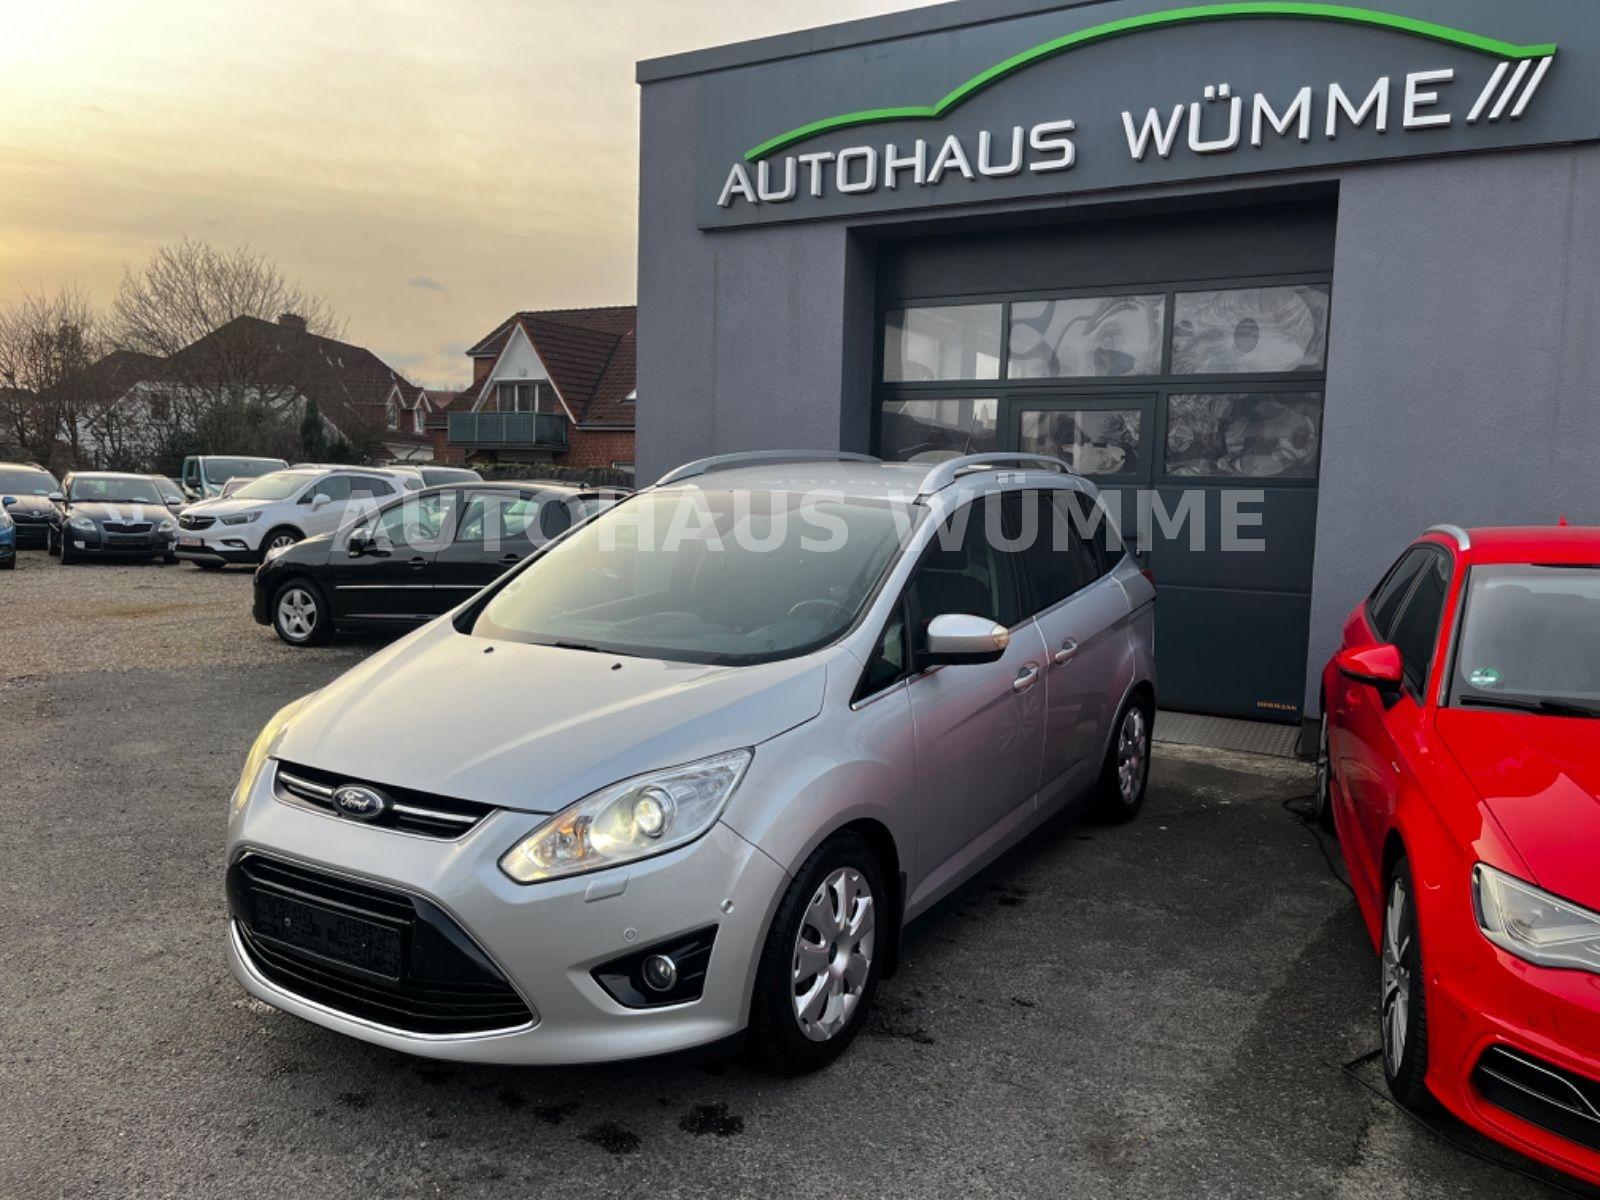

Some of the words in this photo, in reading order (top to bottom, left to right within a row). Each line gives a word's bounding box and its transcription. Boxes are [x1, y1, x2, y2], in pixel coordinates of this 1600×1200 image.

[717, 118, 1076, 207] AUTOHAUS
[1122, 68, 1454, 161] WÜMME
[341, 791, 369, 810] Ford
